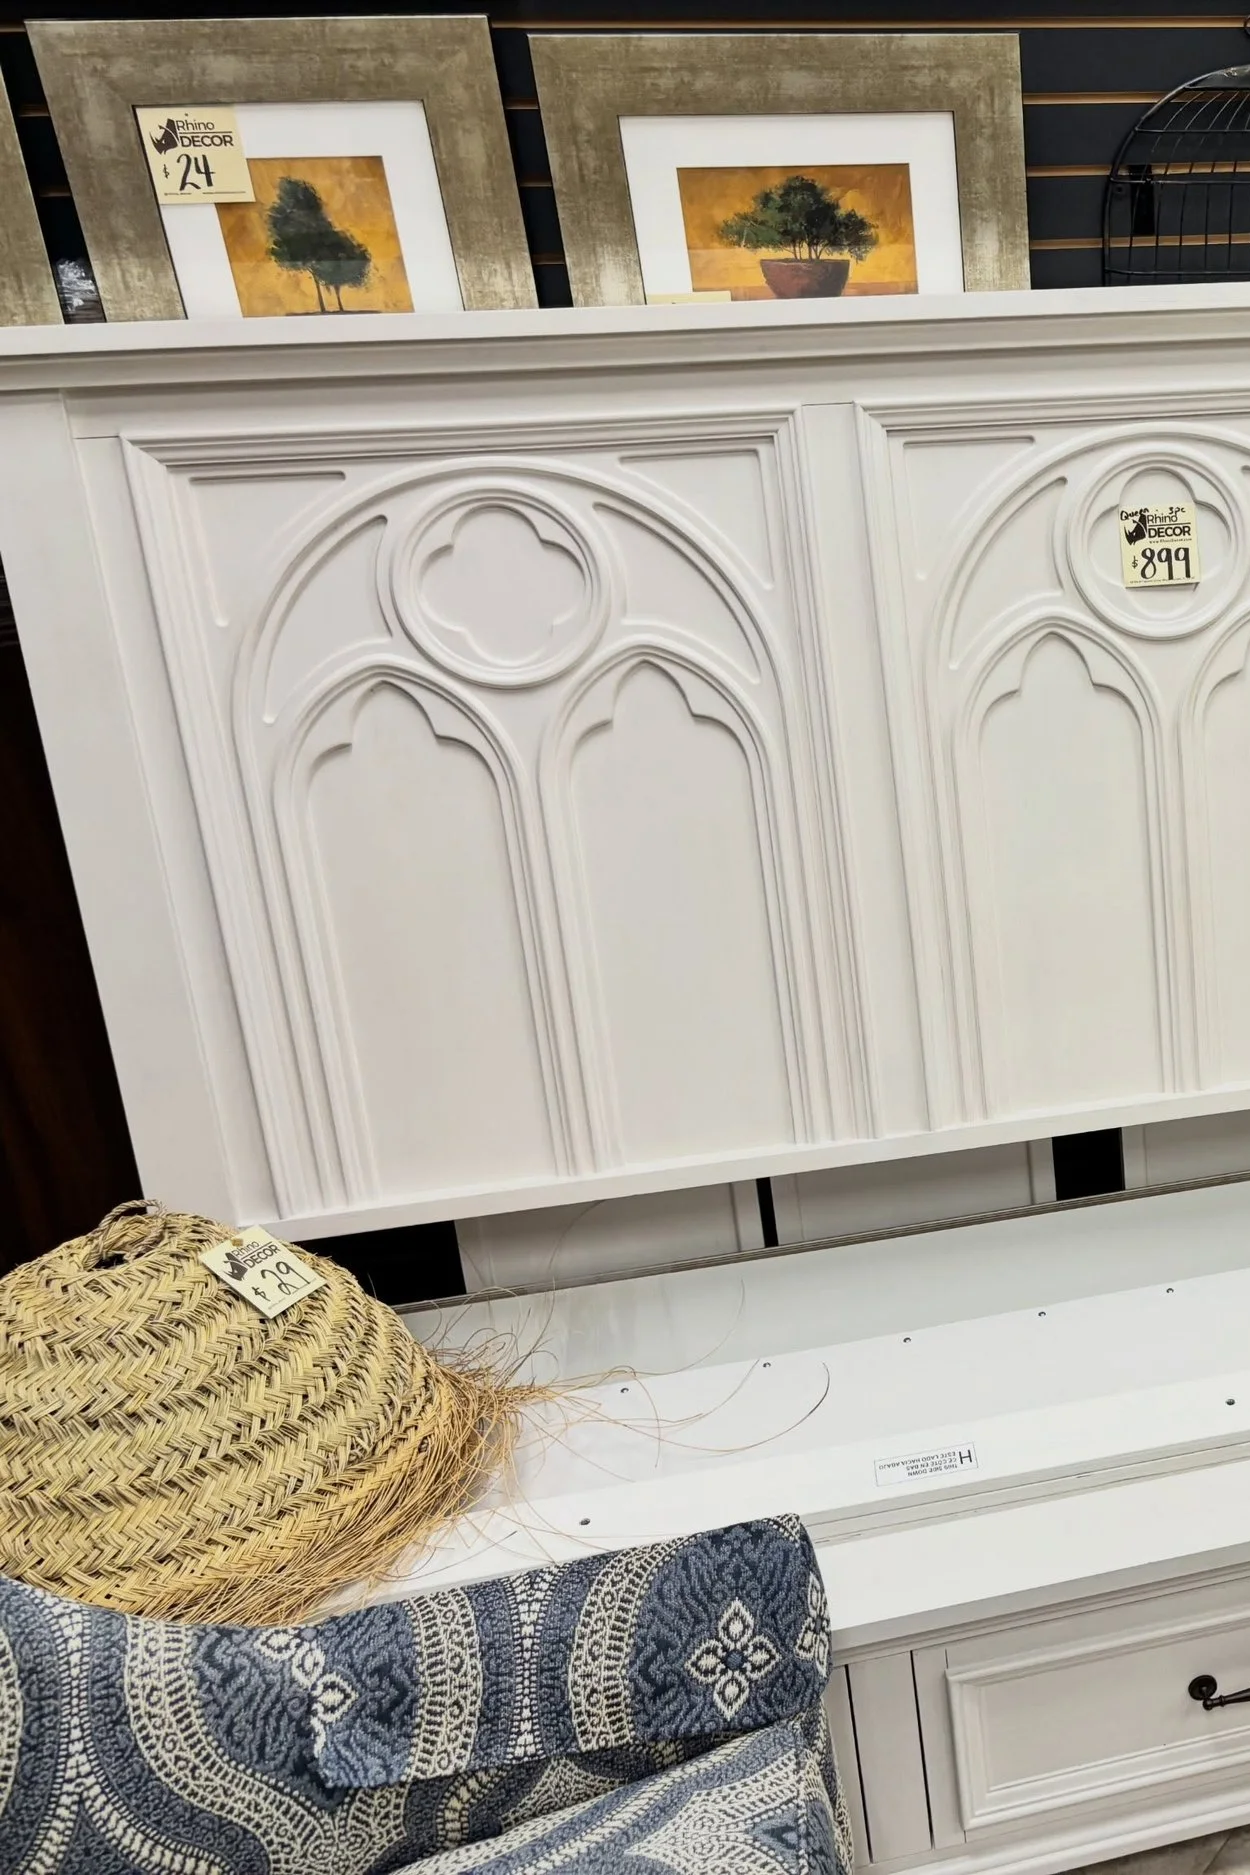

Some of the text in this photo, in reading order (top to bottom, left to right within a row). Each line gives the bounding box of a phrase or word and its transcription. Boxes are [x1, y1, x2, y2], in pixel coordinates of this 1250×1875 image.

[176, 119, 215, 131] Rhino
[180, 135, 234, 147] DECOR
[1147, 513, 1178, 524] Rhino
[1148, 525, 1191, 538] DECOR
[243, 1244, 281, 1268] DECOR
[959, 1449, 972, 1464] H
